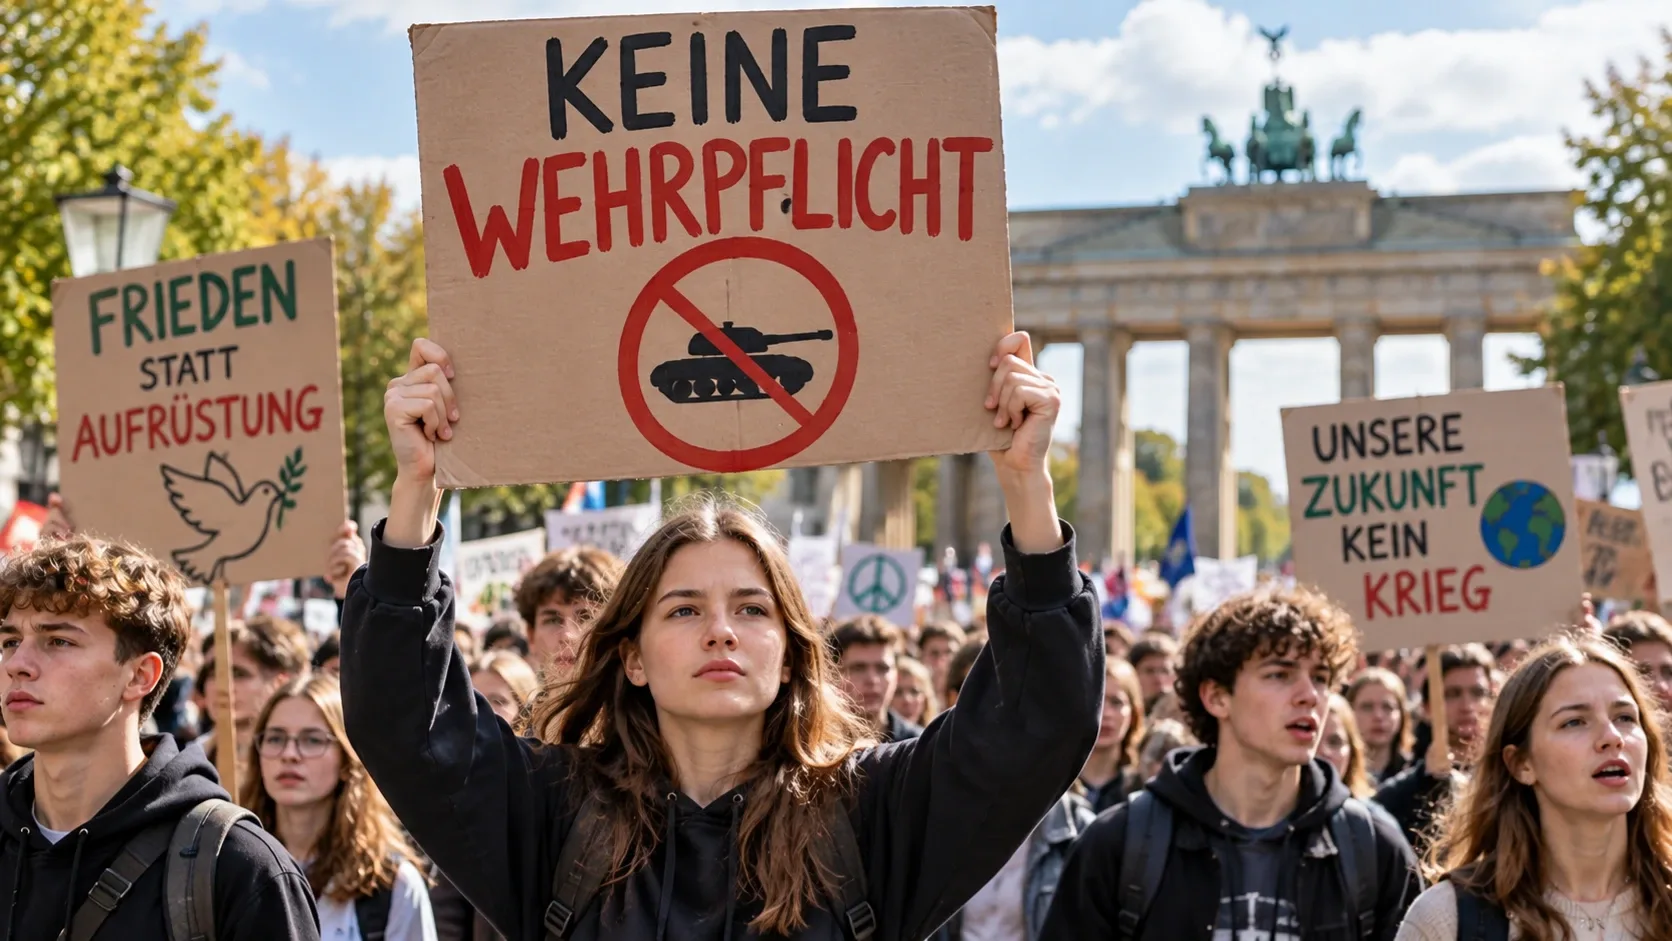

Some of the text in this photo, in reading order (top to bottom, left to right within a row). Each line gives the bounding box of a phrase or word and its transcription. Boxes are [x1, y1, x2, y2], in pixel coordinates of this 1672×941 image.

[545, 24, 858, 141] KEINE
[442, 136, 994, 279] WEHRPFLICHT
[88, 259, 297, 355] FRIEDEN
[139, 345, 239, 391] STATT
[72, 384, 324, 463] AUFRÜSTUNG
[1312, 412, 1464, 463] UNSERE
[1301, 463, 1484, 519] ZUKUNFT
[1342, 520, 1428, 563] KEIN
[1363, 564, 1492, 620] KRIEG
